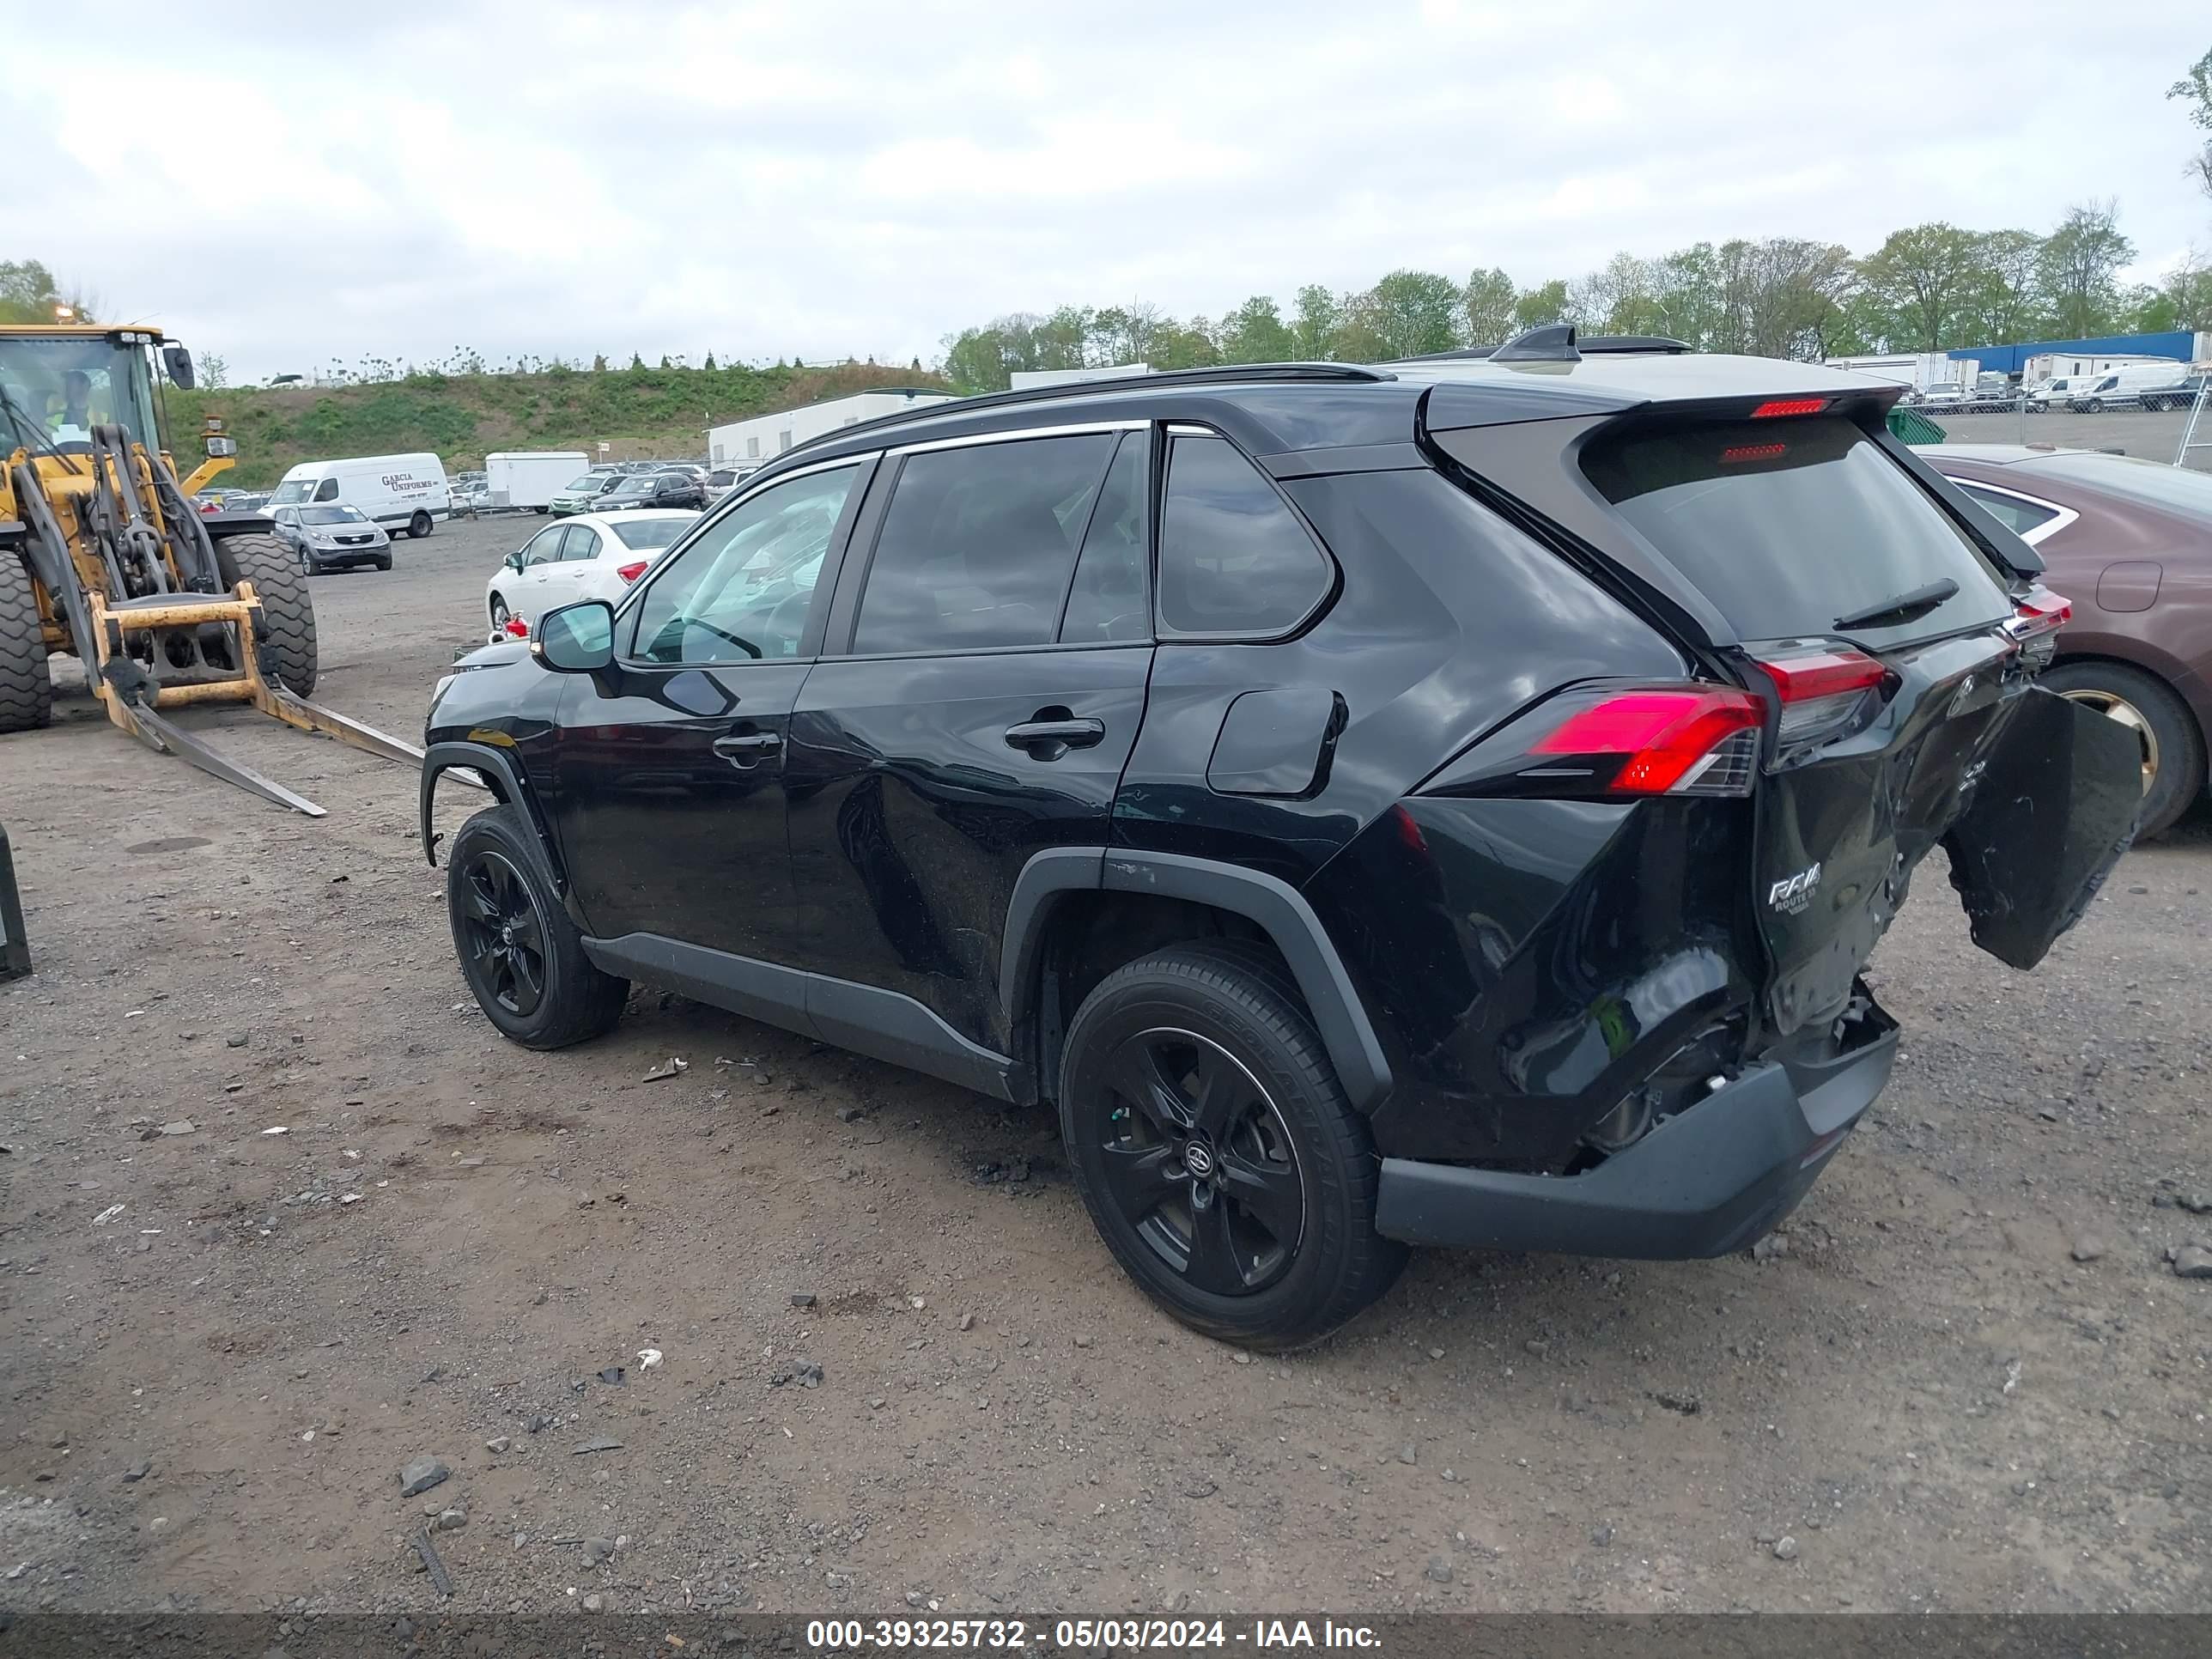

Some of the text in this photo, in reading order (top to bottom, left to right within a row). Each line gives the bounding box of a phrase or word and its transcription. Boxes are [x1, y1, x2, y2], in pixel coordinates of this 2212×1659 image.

[381, 473, 413, 486] GARCIA
[391, 481, 433, 491] UNIFORMS
[1775, 892, 1808, 912] ROUTE
